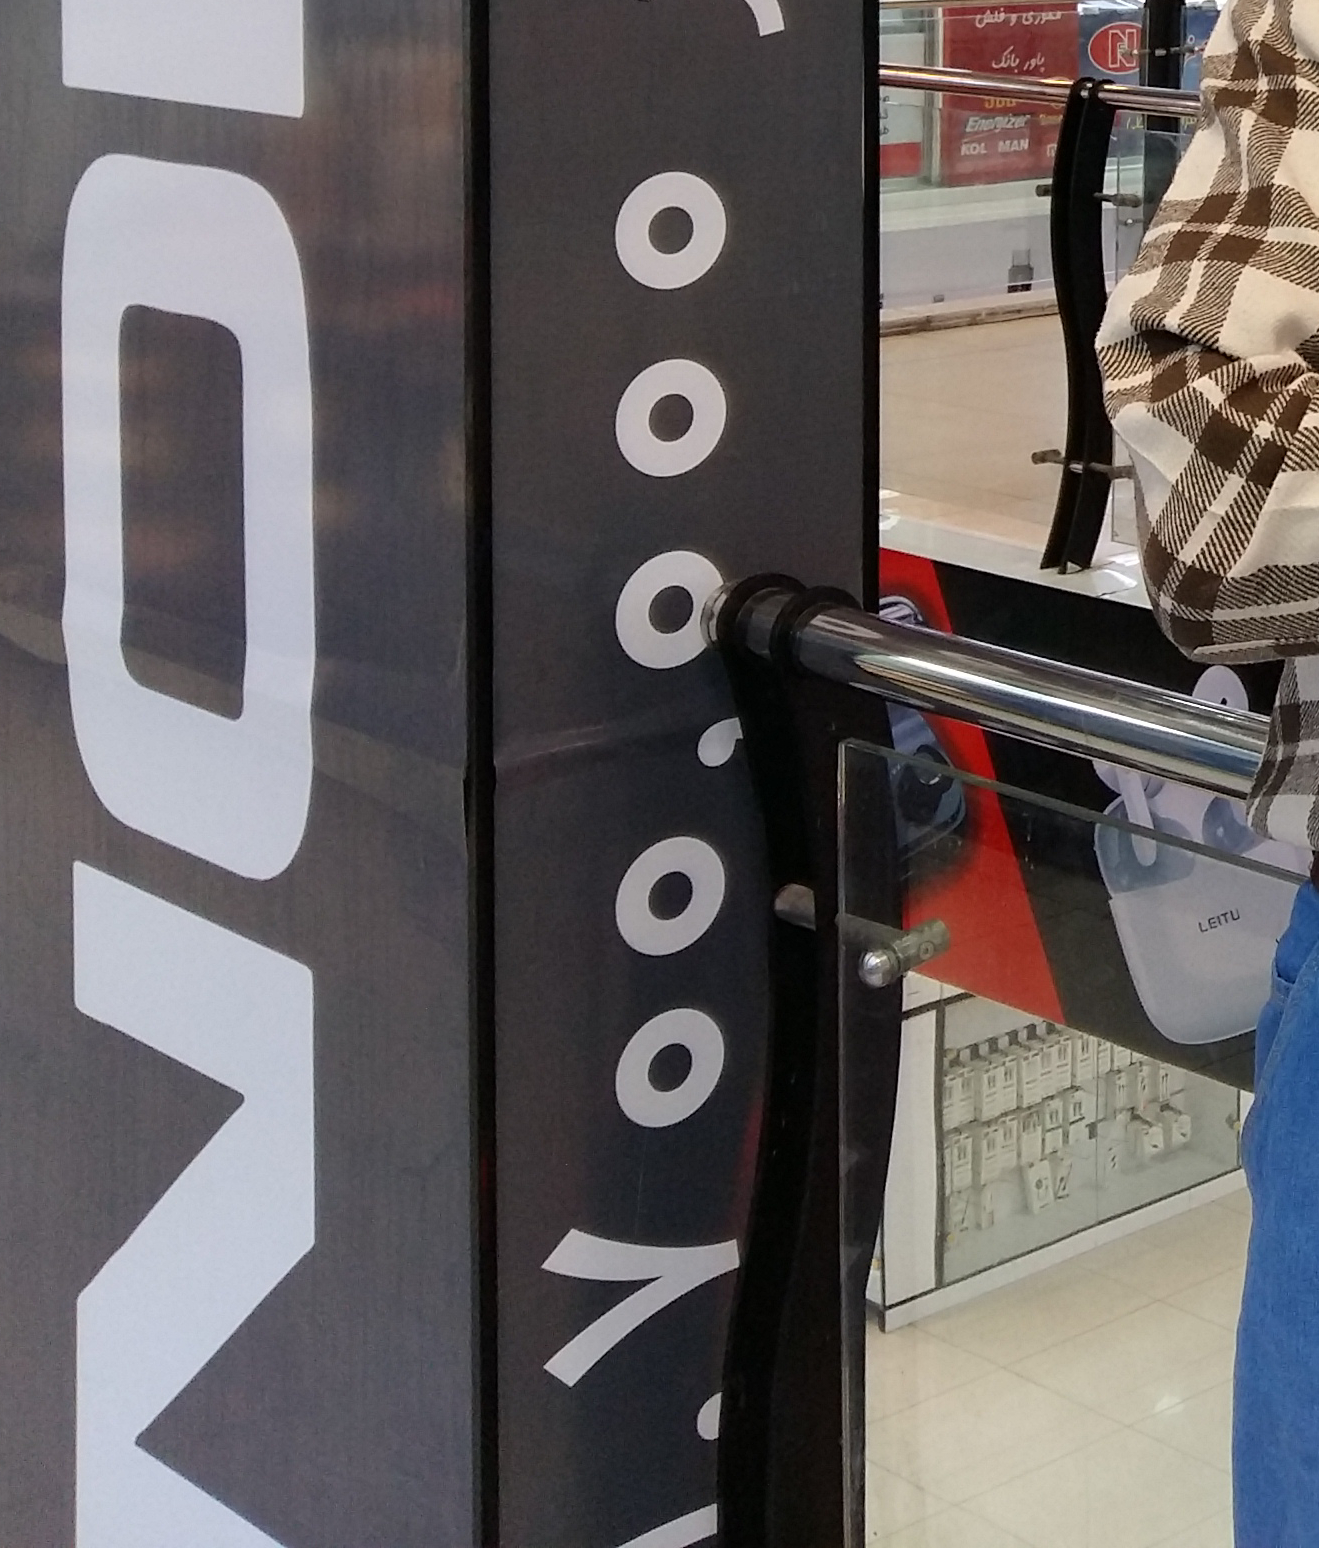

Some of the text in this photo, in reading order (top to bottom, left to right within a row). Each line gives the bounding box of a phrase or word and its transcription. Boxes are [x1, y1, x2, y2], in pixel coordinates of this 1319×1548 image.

[975, 6, 1005, 29] فلش
[1009, 13, 1018, 27] و
[991, 45, 1045, 73] پاور بانک
[1198, 908, 1241, 933] LEITU
